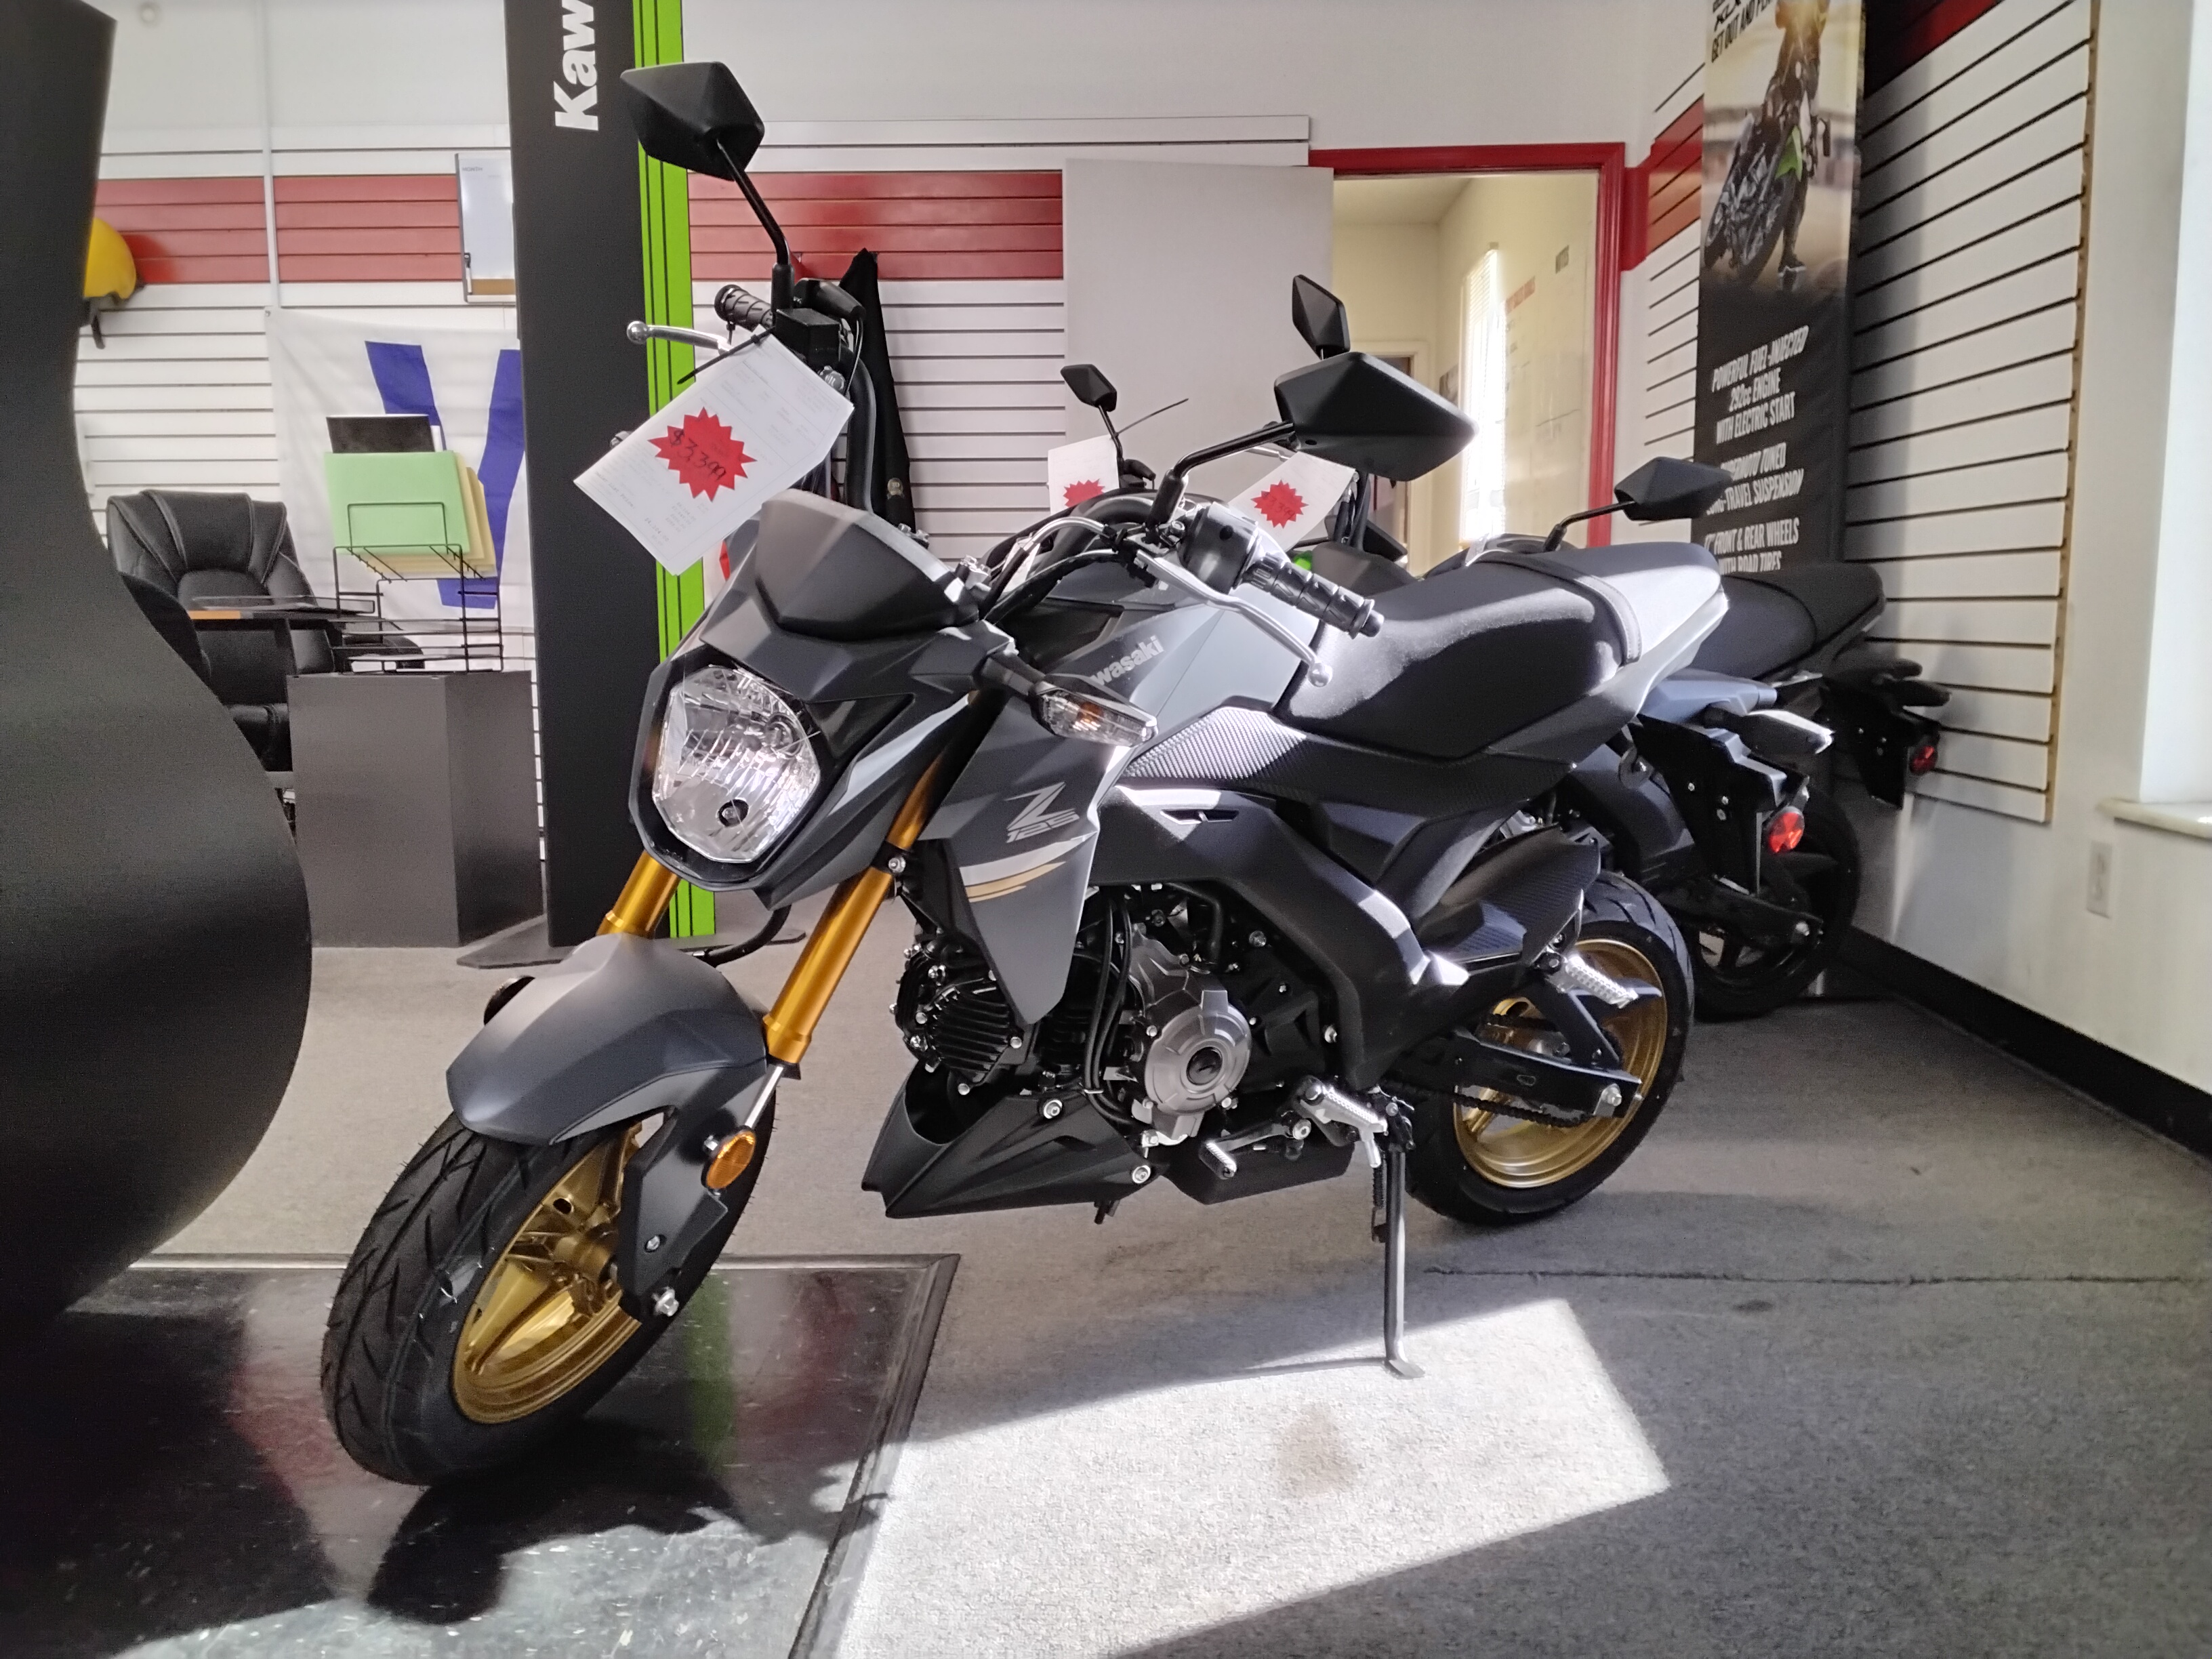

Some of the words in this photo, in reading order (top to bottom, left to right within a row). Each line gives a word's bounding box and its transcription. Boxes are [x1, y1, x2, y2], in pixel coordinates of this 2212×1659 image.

[1712, 354, 1748, 392] POWERFUL
[1752, 367, 1781, 403] ENGINE
[1717, 415, 1734, 445] WITH
[1734, 402, 1769, 438] ELECTRIC
[1769, 391, 1796, 426] START
[1760, 442, 1786, 474] TUNED
[1753, 468, 1804, 505] SUSPENSION
[1714, 529, 1738, 555] FRONT
[1737, 528, 1743, 551] &
[1744, 524, 1765, 550] REAR
[1765, 517, 1800, 547] WHEELS
[1718, 556, 1736, 575] WITH
[1738, 554, 1759, 573] ROAD
[1759, 550, 1782, 571] TIRES
[1003, 781, 1076, 832] Z
[1006, 811, 1080, 844] 125
